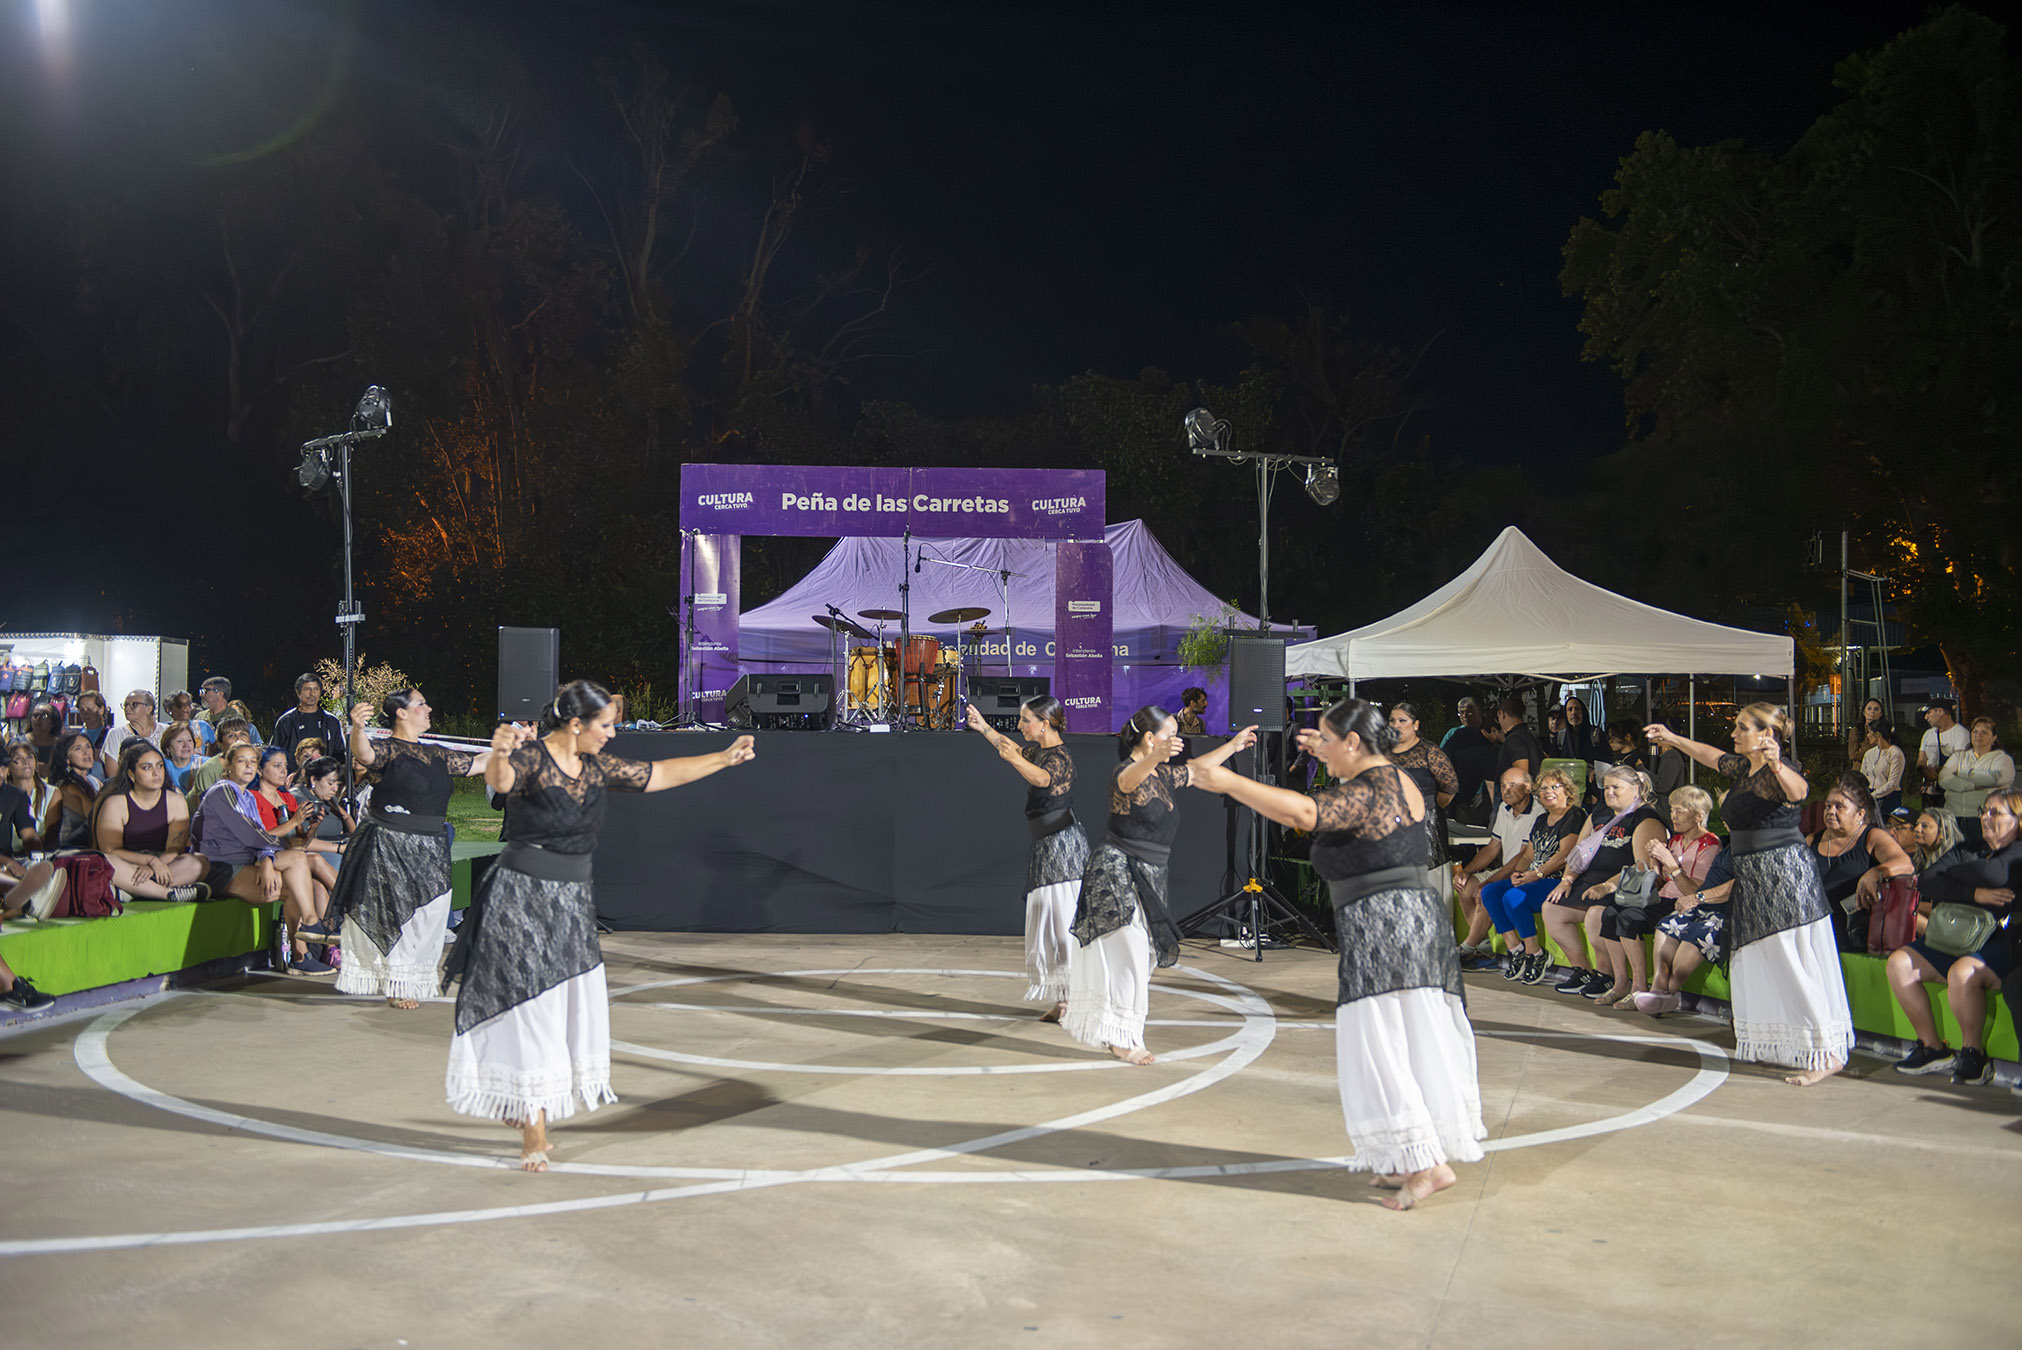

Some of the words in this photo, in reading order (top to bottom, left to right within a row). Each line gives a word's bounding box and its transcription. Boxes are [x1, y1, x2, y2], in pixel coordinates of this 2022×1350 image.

[697, 492, 754, 506] CULTURA
[782, 492, 838, 511] Peña
[842, 493, 871, 511] de
[876, 494, 908, 513] las
[912, 494, 1010, 513] Carretas
[1031, 496, 1087, 511] CULTURA
[1015, 640, 1037, 656] de
[1064, 696, 1102, 706] CULTURA
